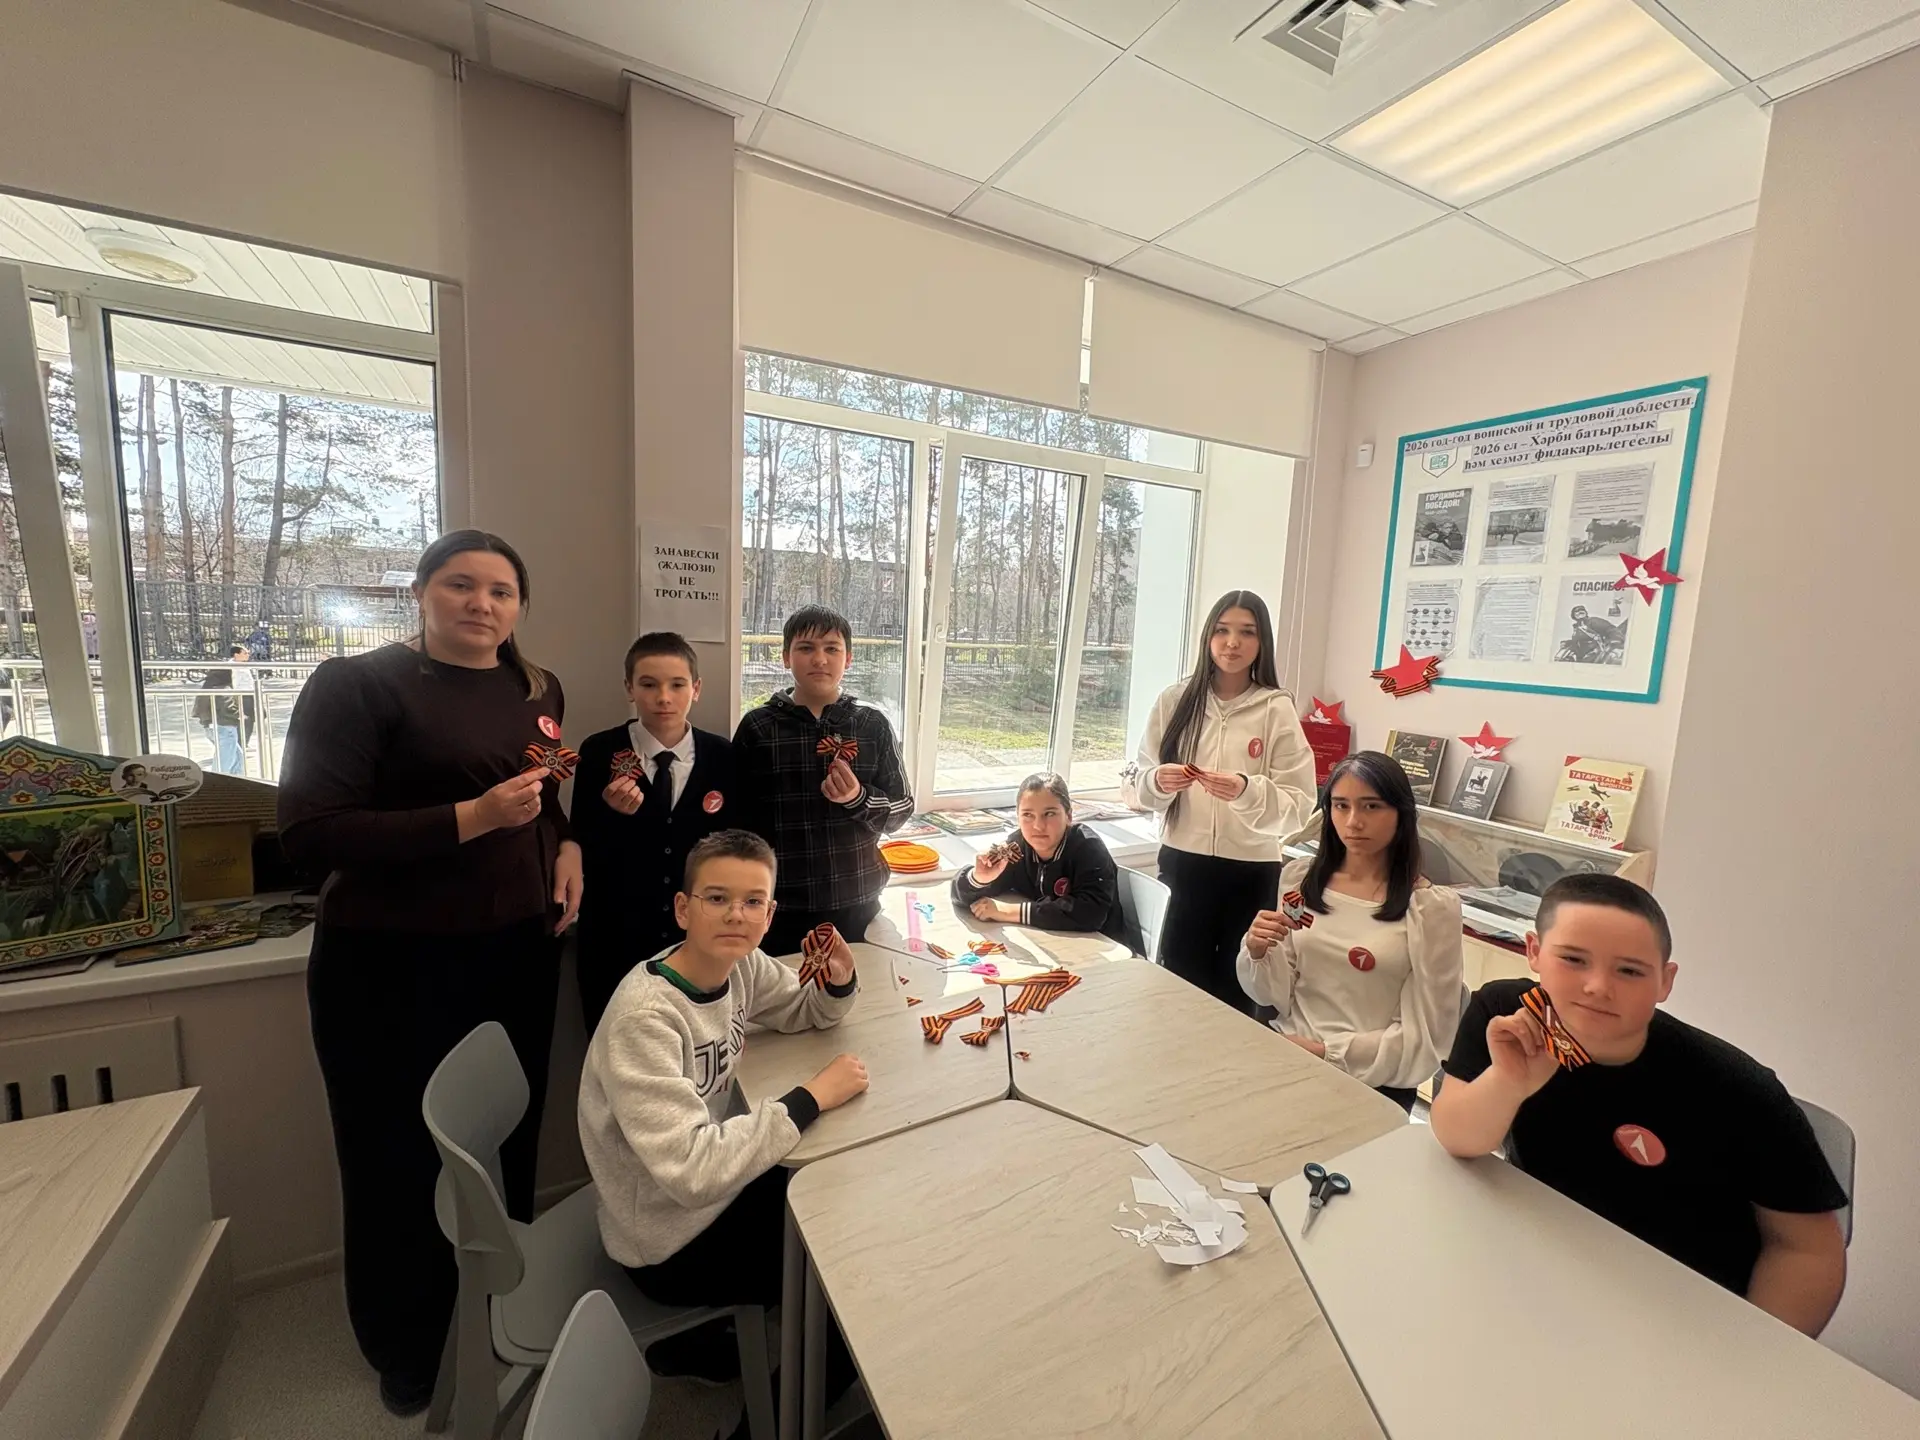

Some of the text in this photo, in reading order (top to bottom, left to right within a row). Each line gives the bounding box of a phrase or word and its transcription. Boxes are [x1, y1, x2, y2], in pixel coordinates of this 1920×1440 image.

[1404, 440, 1428, 452] 2026
[1431, 434, 1471, 449] год-год
[1474, 421, 1533, 440] воинской
[1536, 421, 1544, 430] и
[1549, 406, 1615, 430] трудовой
[1473, 444, 1501, 456] 2026
[1503, 442, 1518, 452] ел
[1575, 418, 1657, 441] батырлык
[1464, 458, 1487, 470] һәм
[1489, 454, 1530, 466] хезмәт
[1637, 433, 1670, 446] елы
[1425, 490, 1465, 501] ГОРДИМСЯ
[1424, 499, 1461, 510] ПОБЕДОЙ!
[654, 546, 719, 560] ЗАНАВЕСКИ
[657, 561, 715, 574] (ЖАЛЮЗИ)
[679, 576, 696, 586] НЕ
[1573, 581, 1625, 592] СПАСИБ
[653, 588, 719, 601] ТРОГАТЬ!!!
